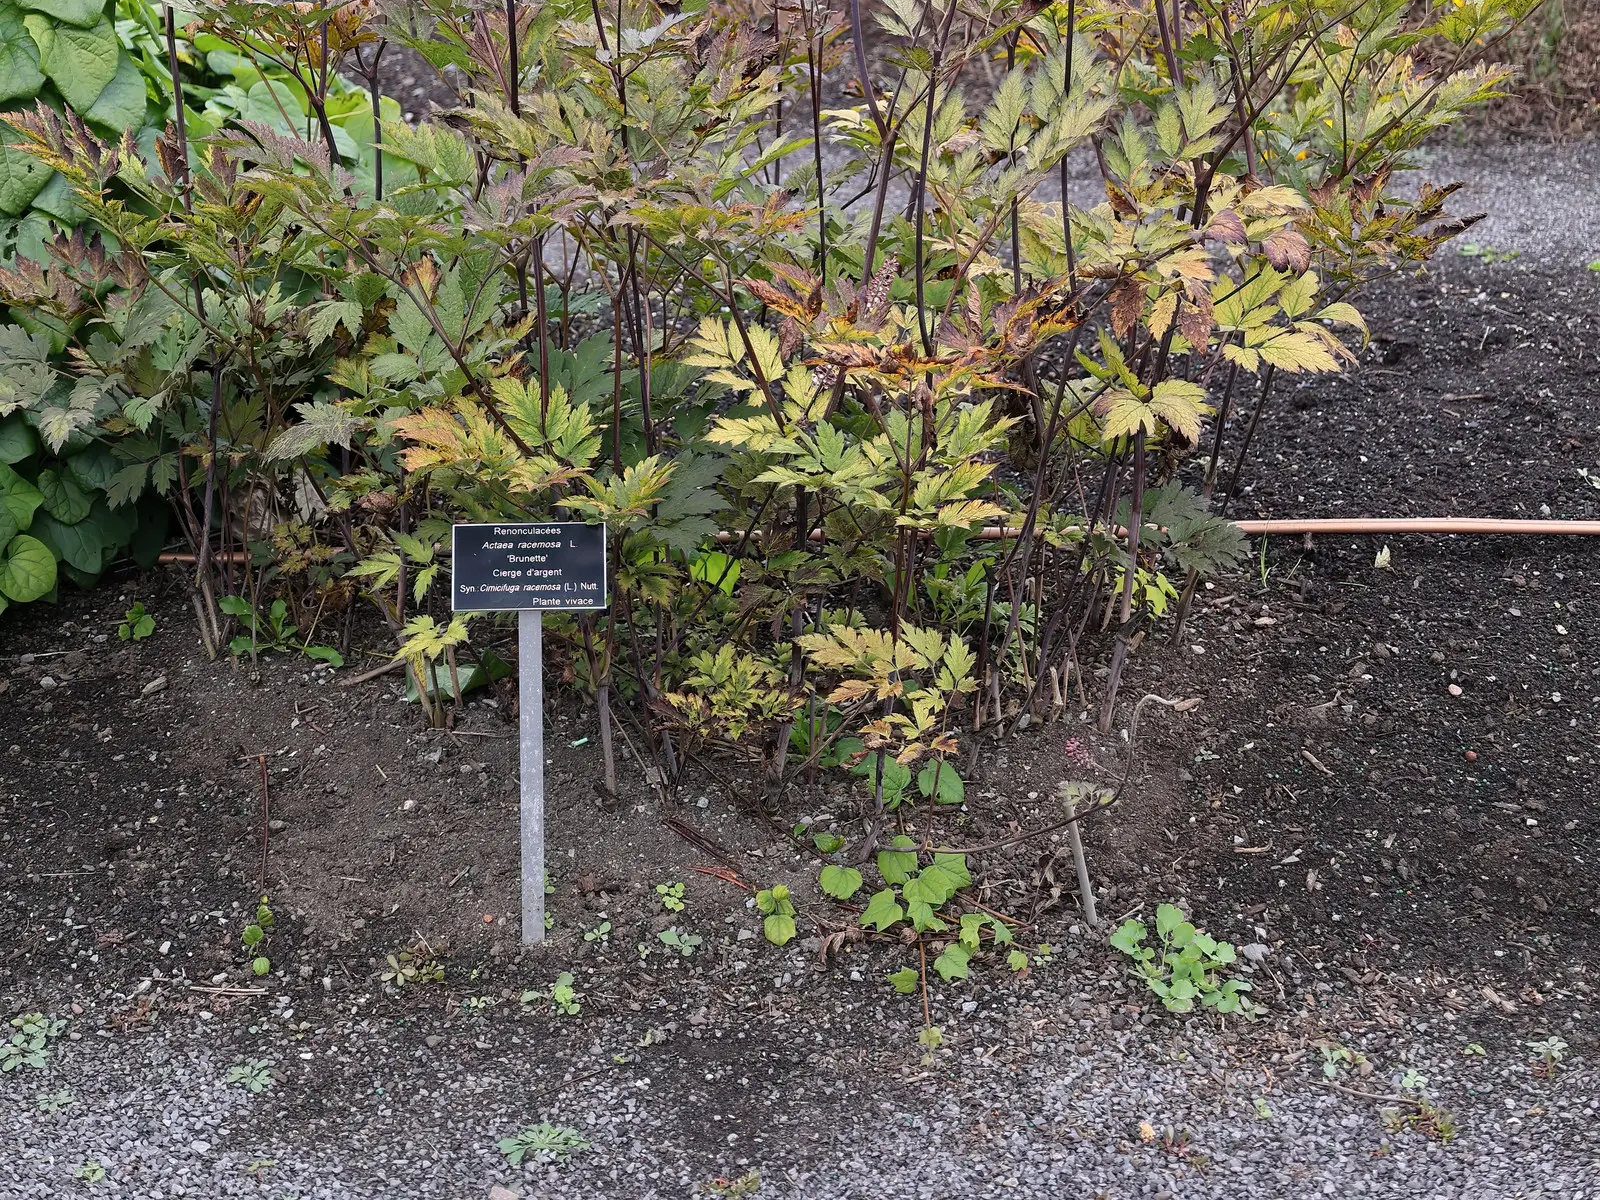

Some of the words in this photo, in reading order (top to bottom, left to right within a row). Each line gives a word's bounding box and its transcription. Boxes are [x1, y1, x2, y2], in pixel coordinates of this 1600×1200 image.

[493, 526, 562, 535] Renonculacées
[482, 541, 514, 549] Actaea
[517, 541, 562, 549] racemosa
[506, 554, 548, 563] 'Brunette'
[492, 569, 522, 578] Cierge
[526, 568, 562, 578] d'argent
[479, 584, 520, 594] Cimicifuga
[580, 582, 599, 590] Nutt.
[532, 597, 561, 606] Plante
[565, 597, 594, 605] vivace
